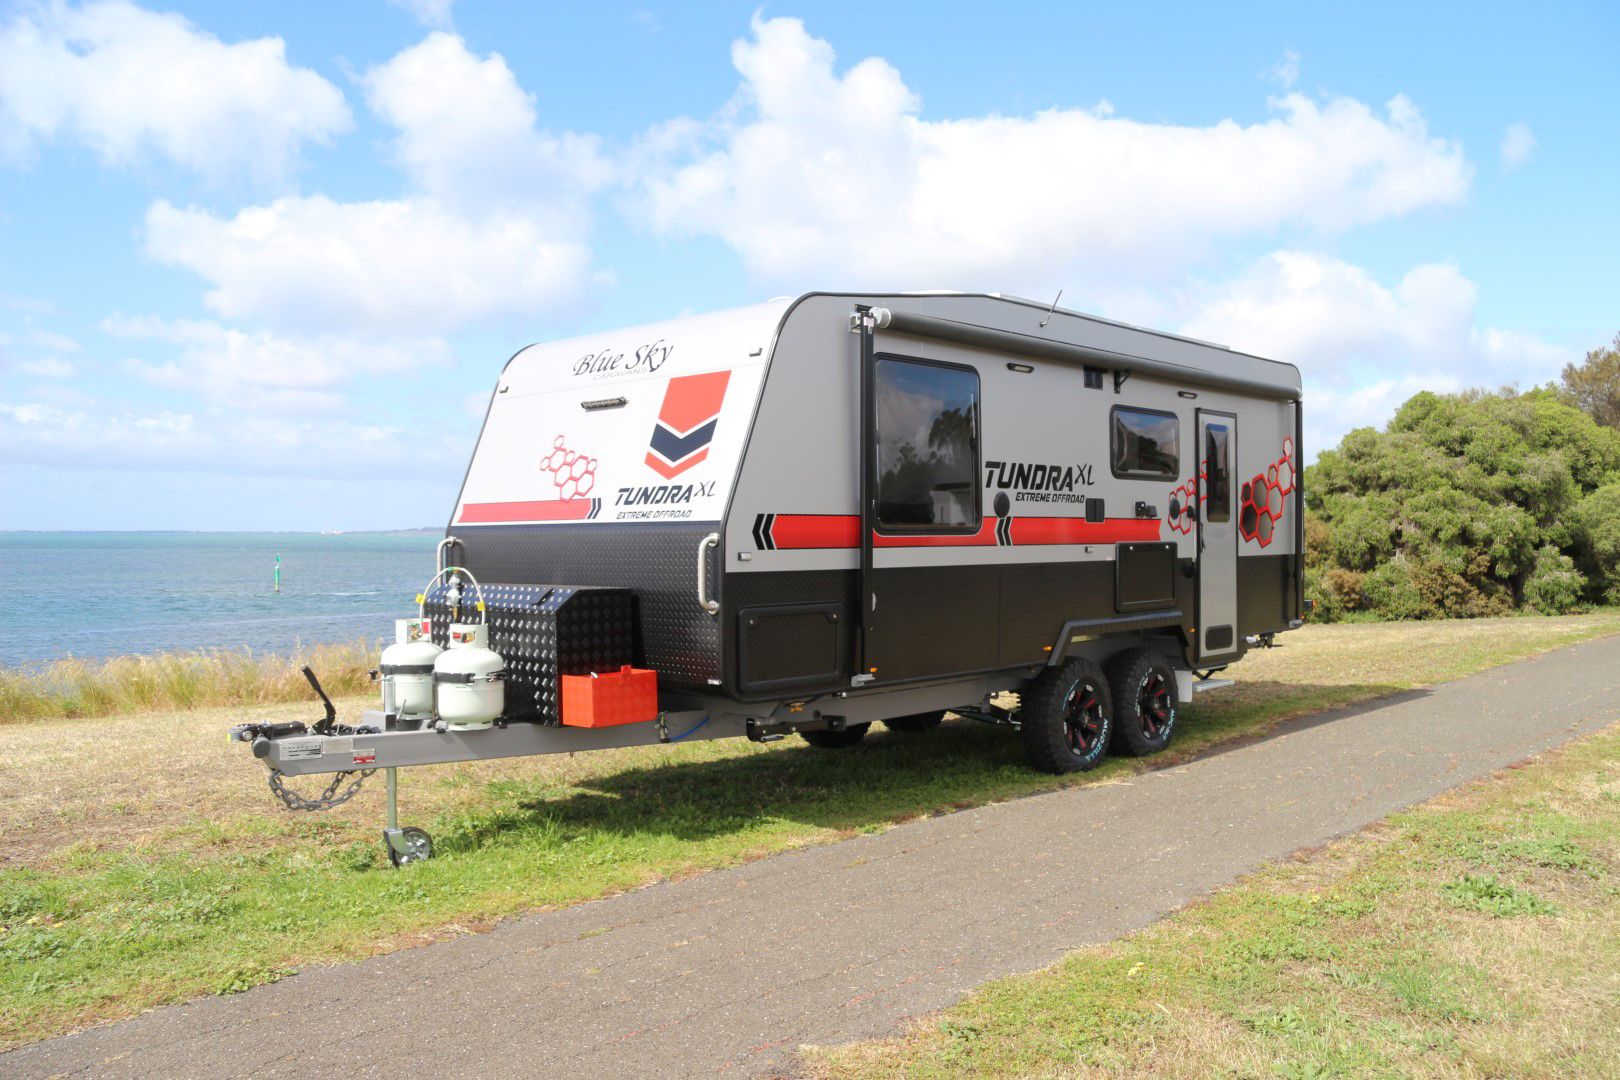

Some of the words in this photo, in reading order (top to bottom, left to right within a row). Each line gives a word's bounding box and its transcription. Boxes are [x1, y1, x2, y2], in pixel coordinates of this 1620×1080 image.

[573, 348, 624, 376] Blue
[625, 339, 674, 372] Sky
[984, 461, 1073, 492] TUNDRA
[1074, 463, 1095, 486] XL
[615, 484, 694, 506] TUNDRA
[694, 480, 716, 497] XL
[1015, 492, 1051, 503] EXTREME
[1051, 493, 1086, 504] OFFROAD
[616, 511, 653, 520] EXTREME
[653, 509, 693, 519] OFFROAD
